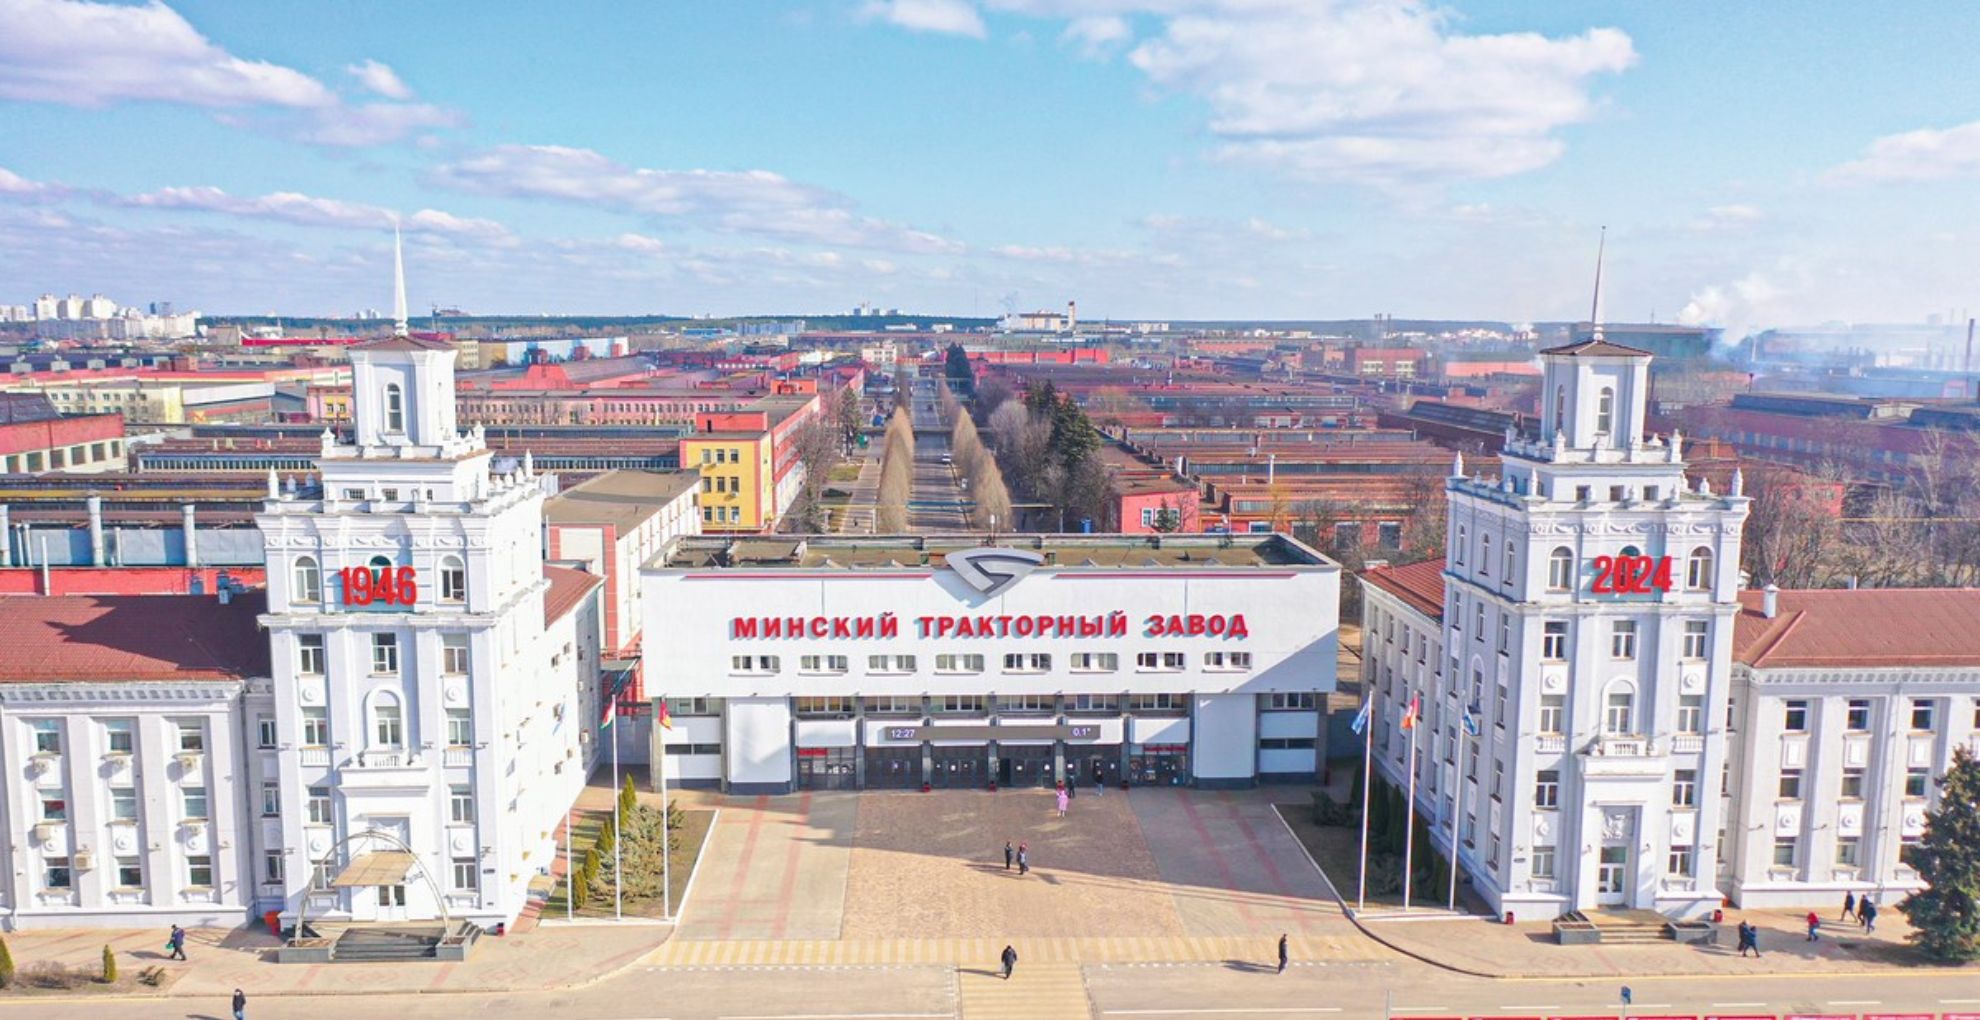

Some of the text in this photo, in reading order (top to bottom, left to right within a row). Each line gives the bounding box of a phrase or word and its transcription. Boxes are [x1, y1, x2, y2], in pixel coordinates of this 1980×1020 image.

[337, 565, 417, 607] 1946
[1591, 554, 1673, 595] 2024
[733, 610, 1249, 639] МИНСКИЙ ТРАКТОРНЫЙ ЗАВОД
[891, 728, 915, 738] 12:27
